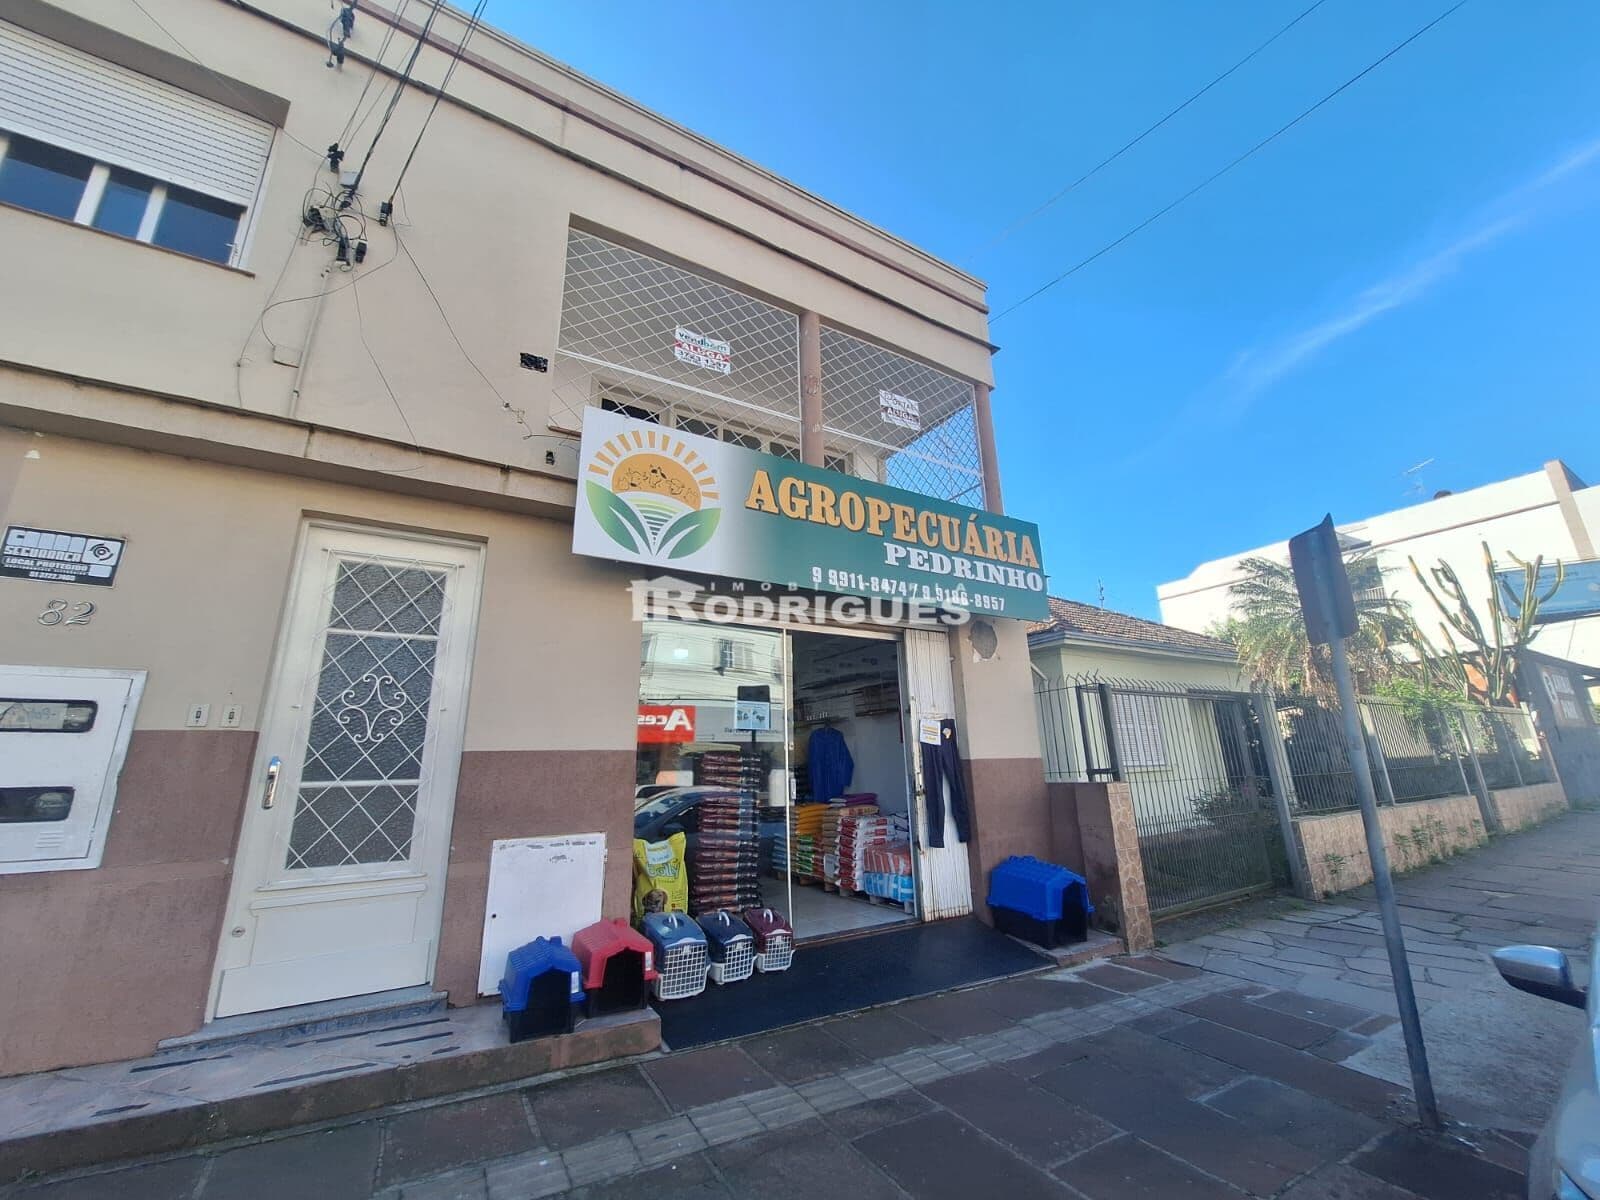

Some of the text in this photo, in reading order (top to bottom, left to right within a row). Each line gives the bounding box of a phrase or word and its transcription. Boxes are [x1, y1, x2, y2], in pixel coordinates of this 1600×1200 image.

[682, 342, 724, 360] ALUGA
[745, 470, 1040, 569] AGROPECUÁRIA
[6, 557, 35, 567] LOCAL
[36, 560, 89, 572] PROTEGIDO
[883, 543, 1044, 592] PEDRINHO
[812, 566, 823, 583] 9
[828, 569, 908, 597] 9911-8474
[38, 600, 96, 626] 82
